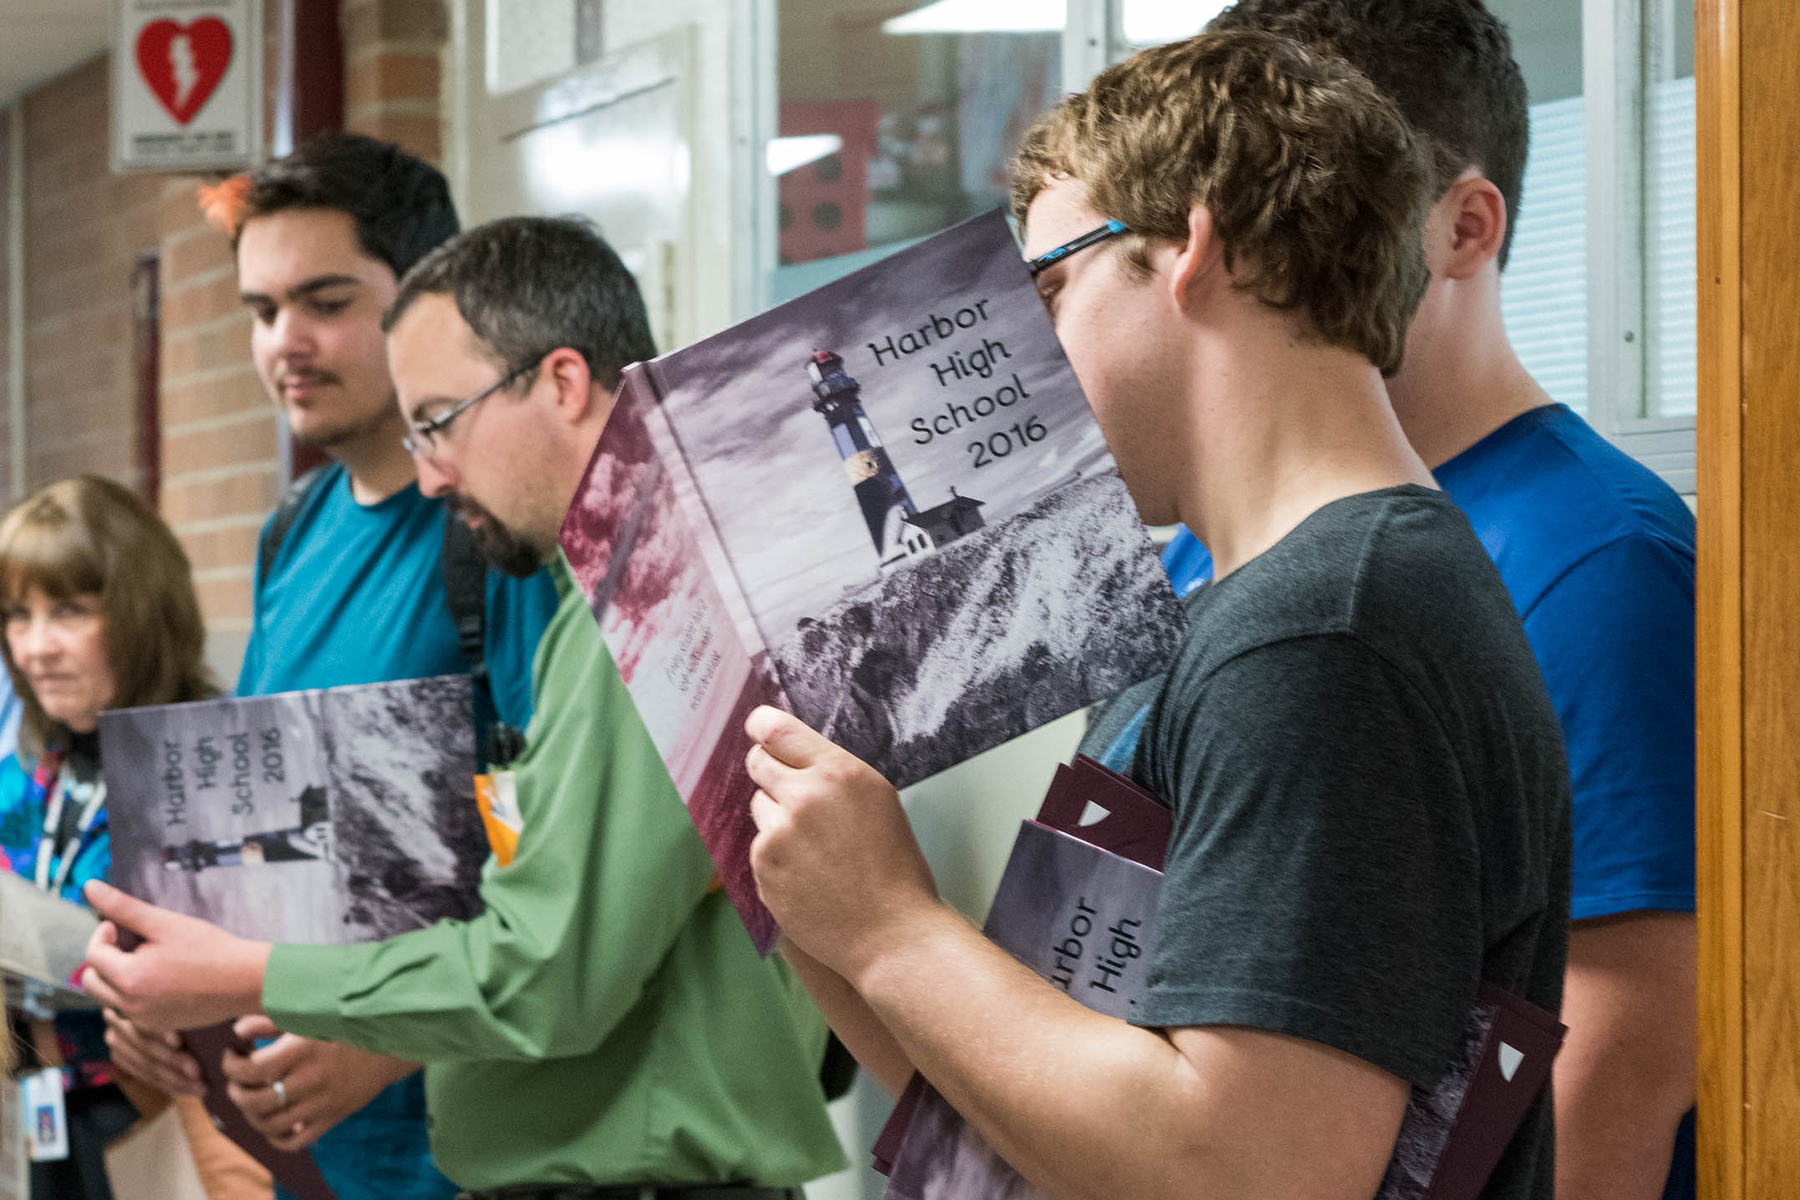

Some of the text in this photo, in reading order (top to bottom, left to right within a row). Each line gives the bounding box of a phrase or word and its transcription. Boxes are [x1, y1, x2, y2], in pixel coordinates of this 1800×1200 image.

[867, 299, 989, 366] Harbor
[929, 338, 1012, 387] High
[911, 373, 1031, 445] School
[967, 415, 1048, 469] 2016
[162, 740, 186, 825] Harbor
[194, 736, 223, 791] High
[226, 732, 254, 816] School
[261, 728, 285, 783] 2016
[1051, 896, 1098, 990] rbor
[1089, 918, 1142, 994] High
